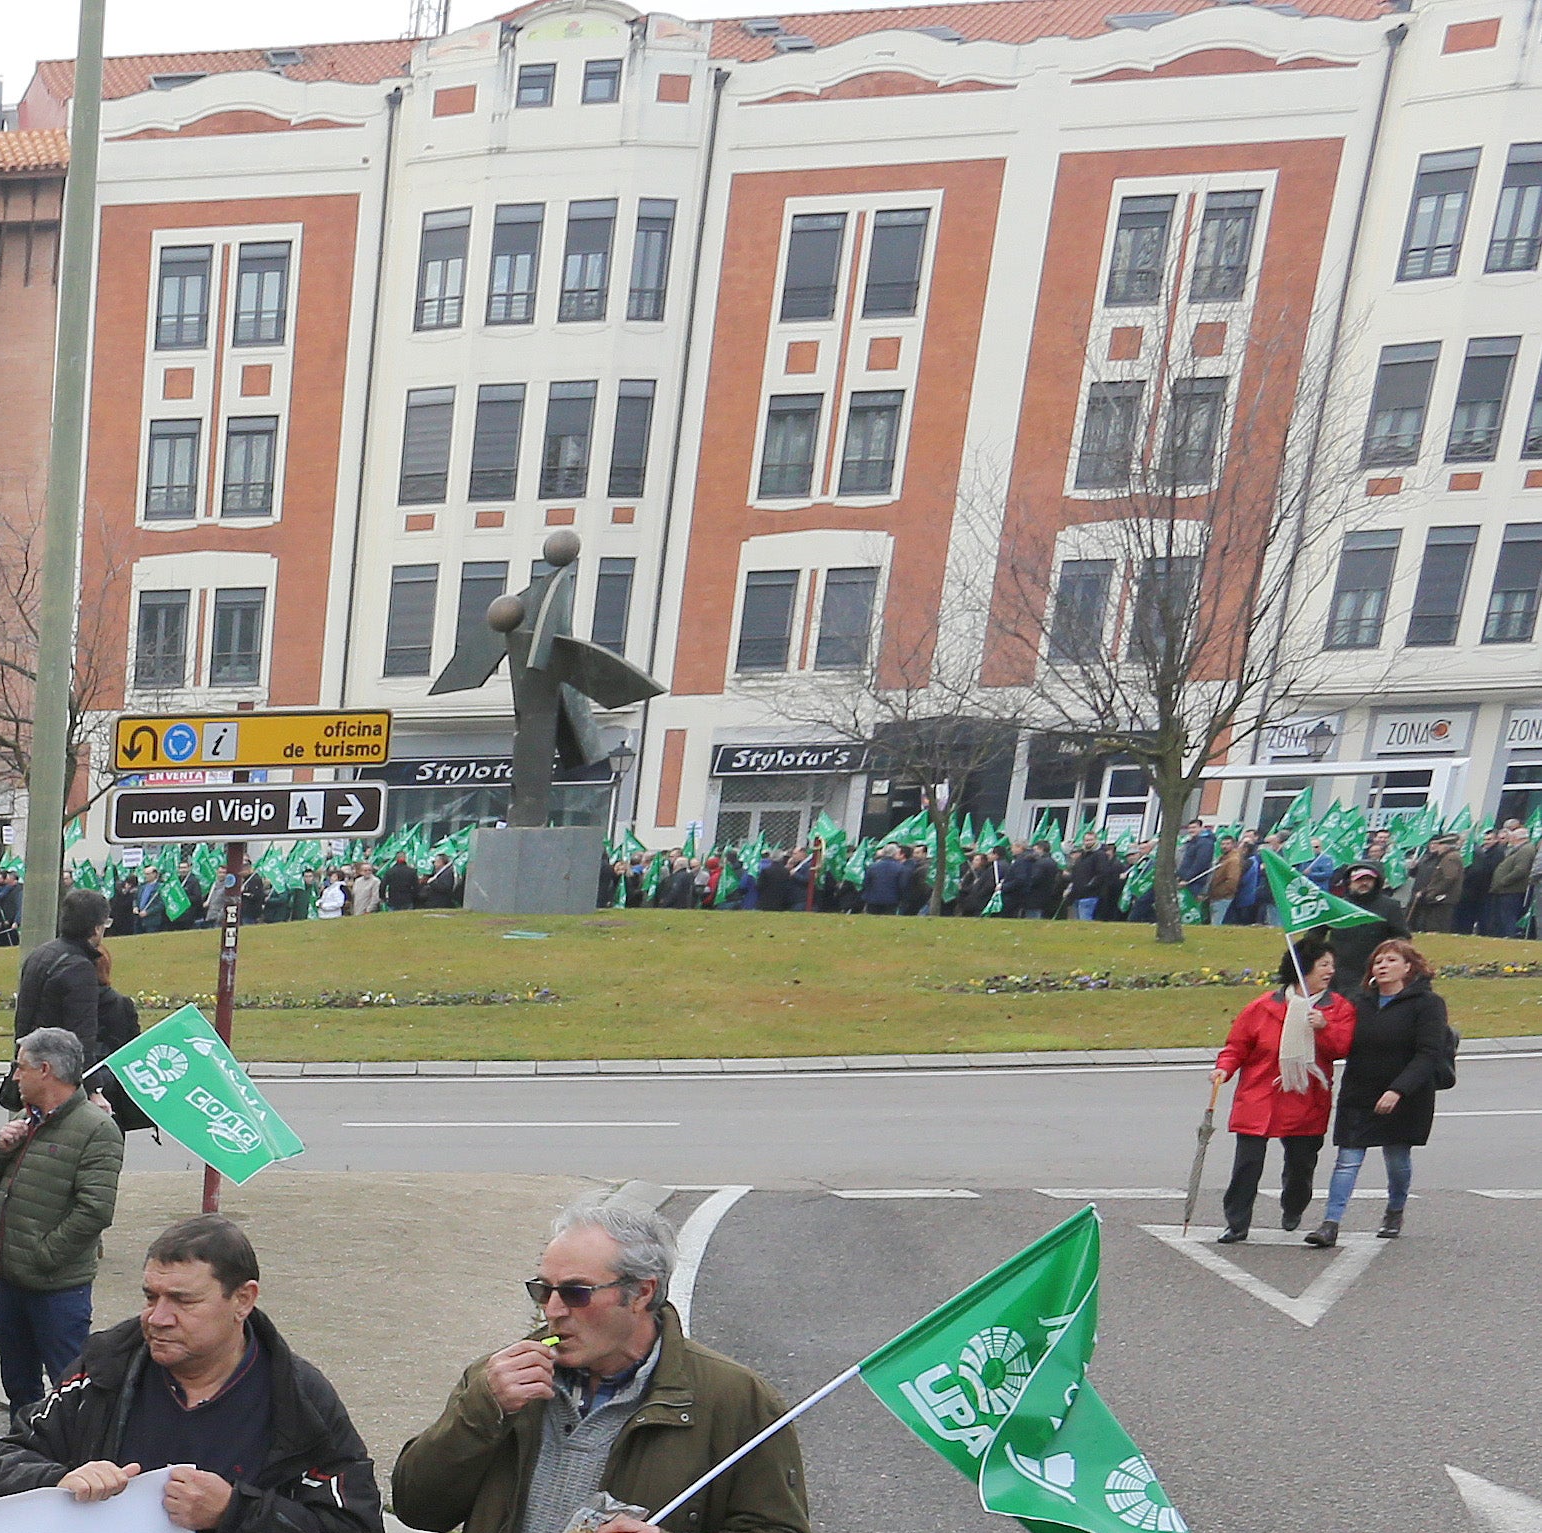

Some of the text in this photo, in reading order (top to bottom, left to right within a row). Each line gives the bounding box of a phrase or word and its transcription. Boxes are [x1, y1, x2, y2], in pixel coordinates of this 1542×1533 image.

[324, 719, 382, 738] oficina
[283, 740, 381, 758] de turismo
[149, 772, 163, 780] EN
[165, 770, 203, 780] VENTA
[131, 798, 276, 827] monte el Viejo
[1290, 899, 1330, 925] UPA
[122, 1058, 169, 1103] UPA
[214, 1055, 269, 1122] ASAJA
[185, 1086, 262, 1148] COAG
[898, 1362, 997, 1458] UPA
